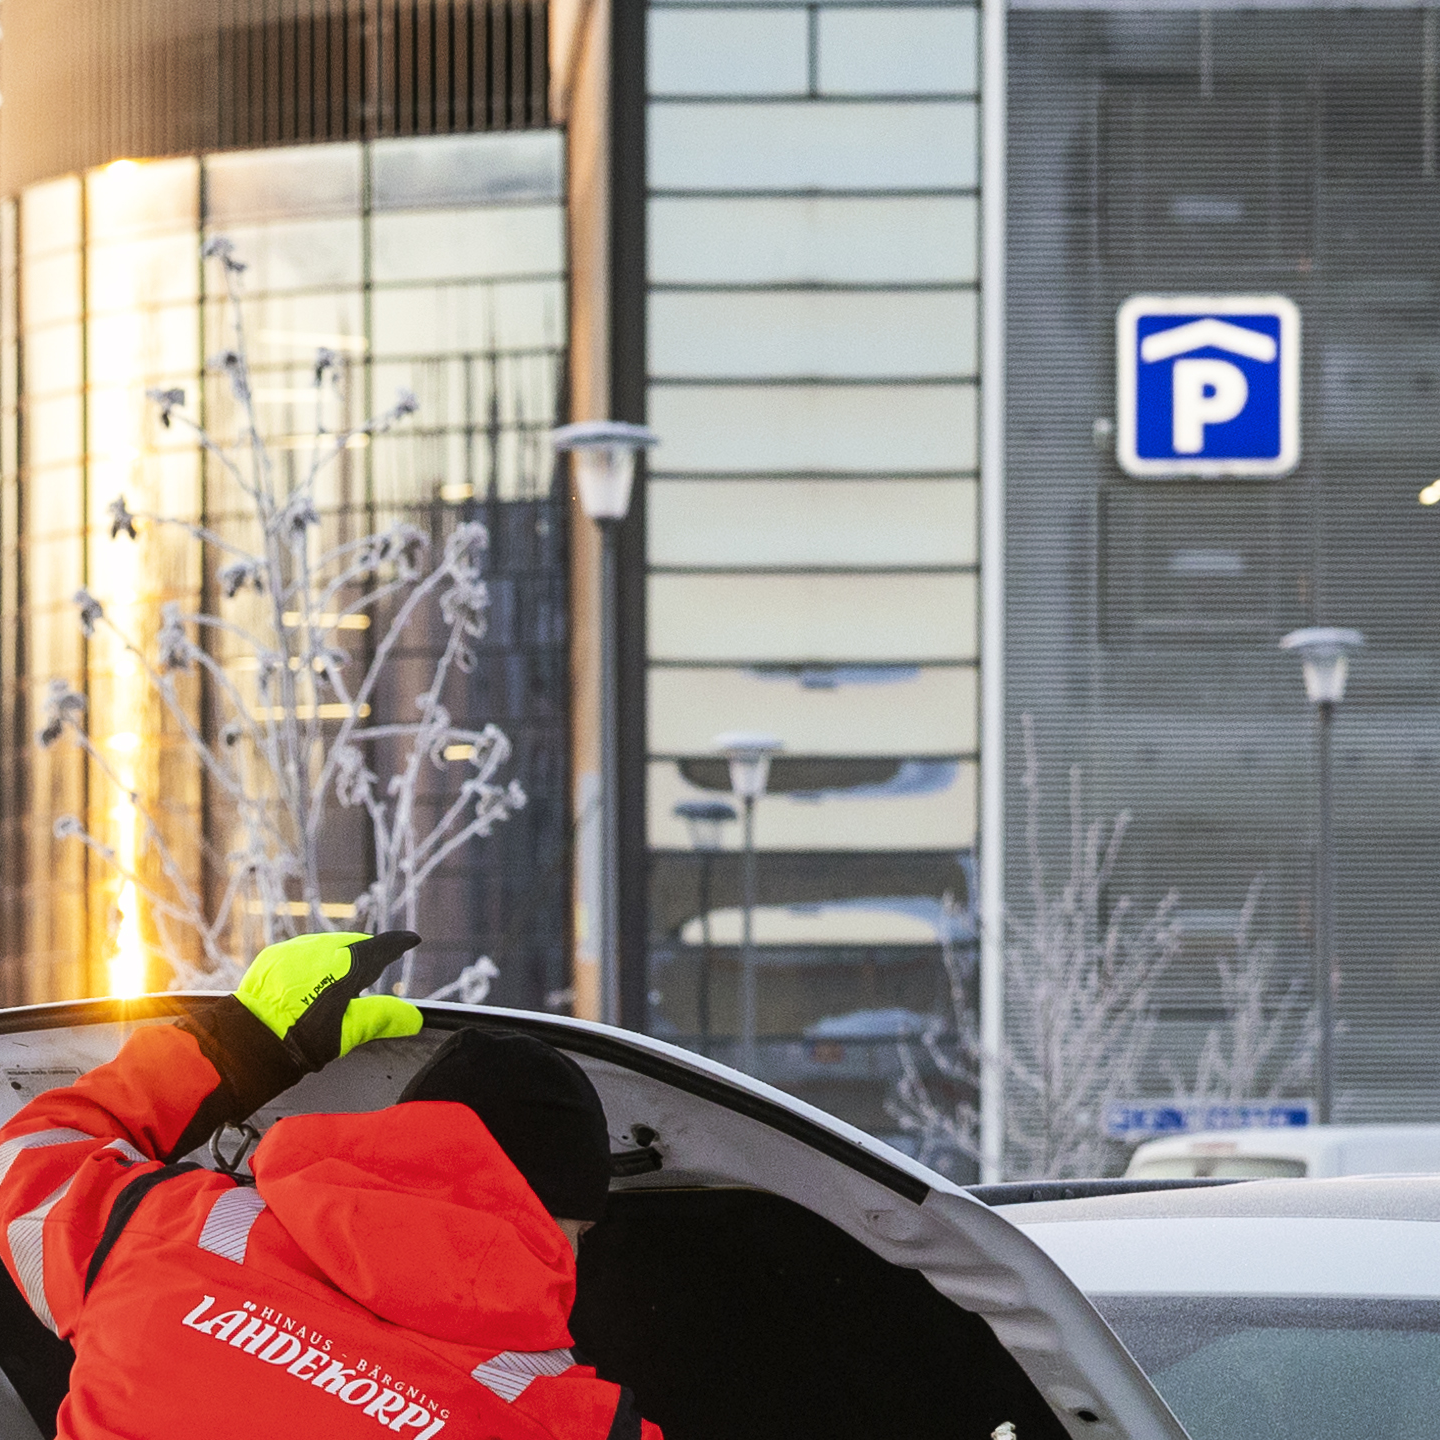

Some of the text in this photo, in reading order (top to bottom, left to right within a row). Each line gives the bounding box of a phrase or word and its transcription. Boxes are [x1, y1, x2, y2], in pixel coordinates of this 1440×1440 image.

[1172, 358, 1249, 454] P
[300, 996, 310, 1006] A
[313, 973, 336, 995] Hand
[261, 1306, 334, 1351] HINAUS
[356, 1358, 450, 1419] BÄRGNING
